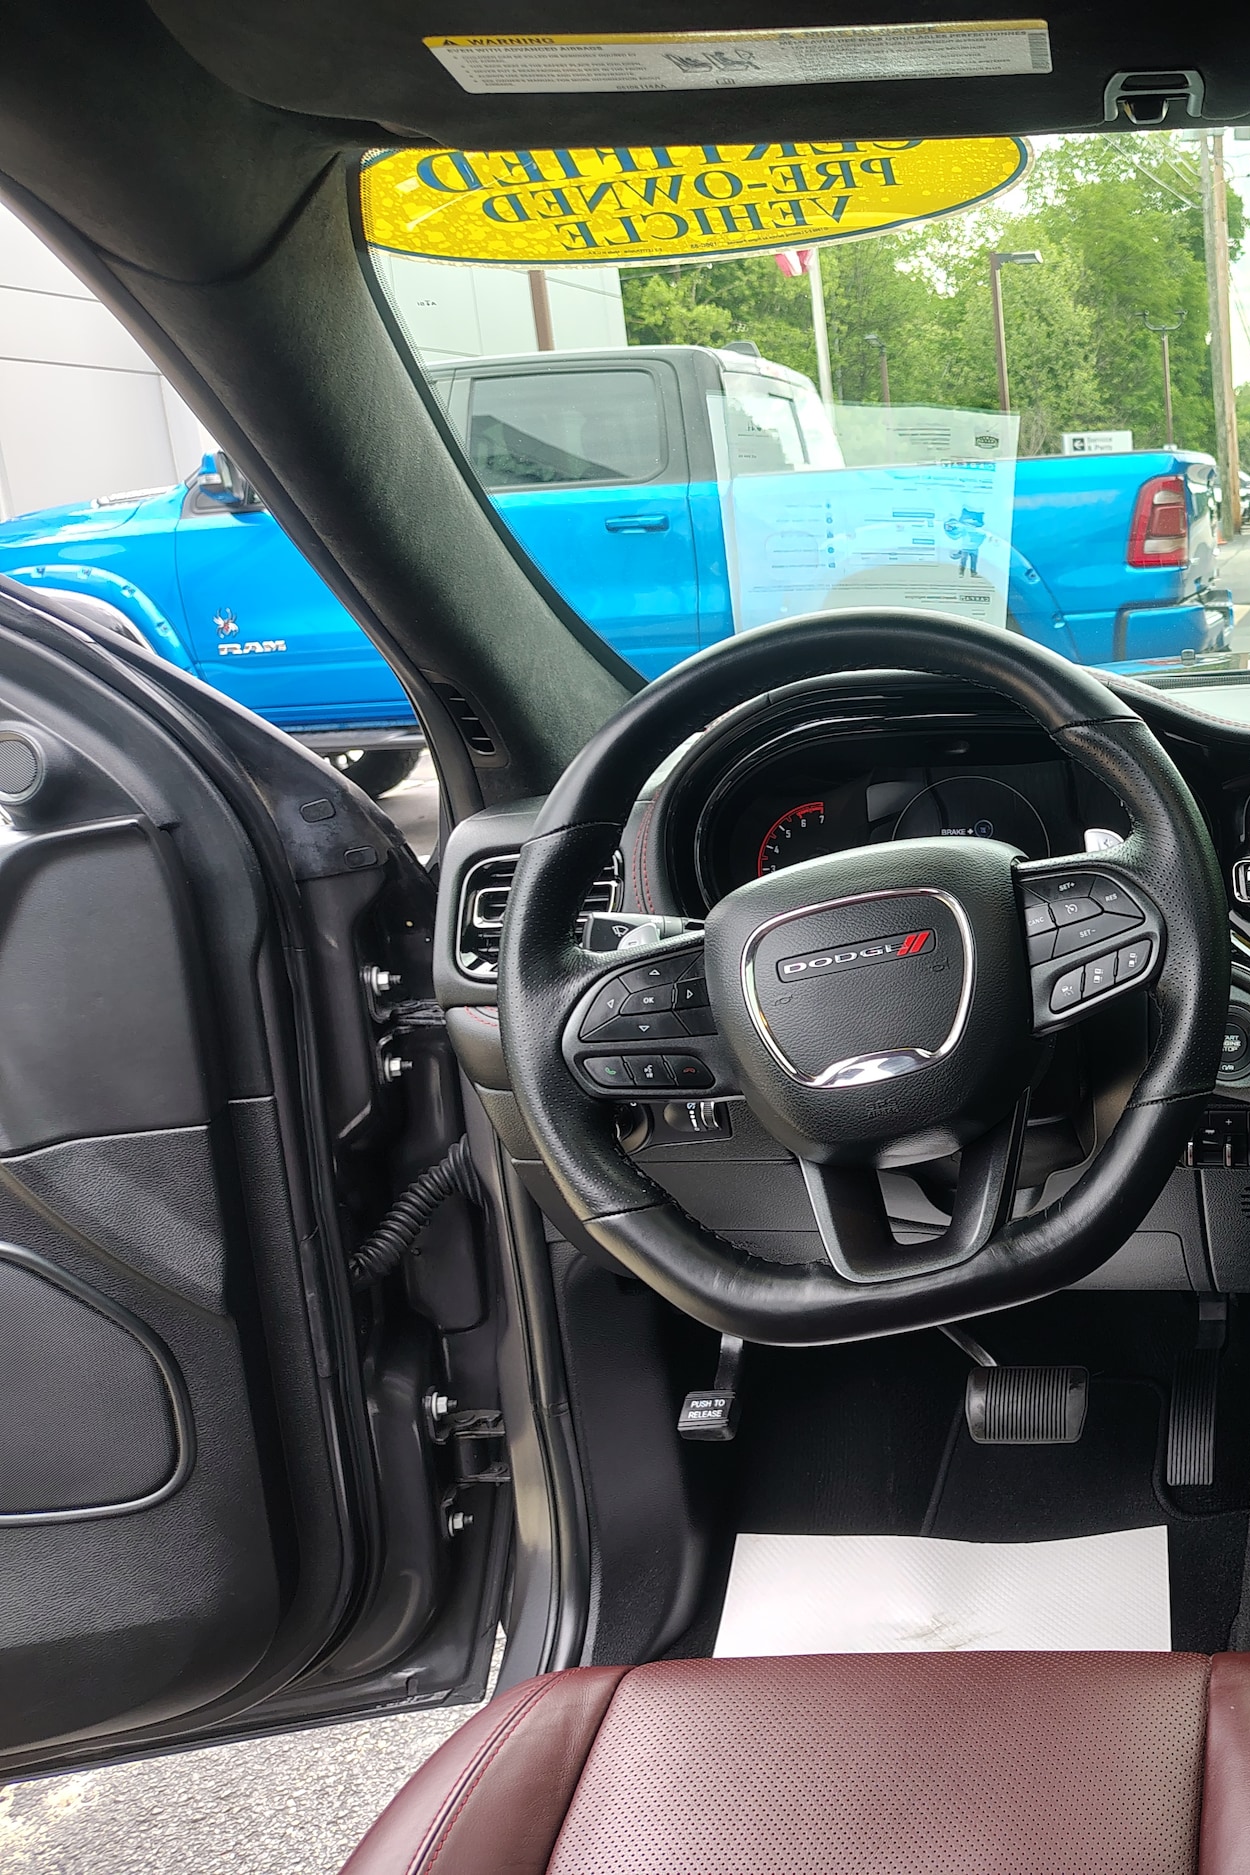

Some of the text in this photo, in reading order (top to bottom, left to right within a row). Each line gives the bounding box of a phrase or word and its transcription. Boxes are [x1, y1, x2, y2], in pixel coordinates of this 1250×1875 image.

[218, 640, 288, 657] RAM
[1058, 881, 1075, 892] SET+
[1105, 893, 1118, 902] RES
[1027, 916, 1044, 926] CANC
[783, 943, 915, 975] DODGE
[690, 1398, 727, 1409] PUSH TO
[688, 1409, 723, 1419] RELEASE
